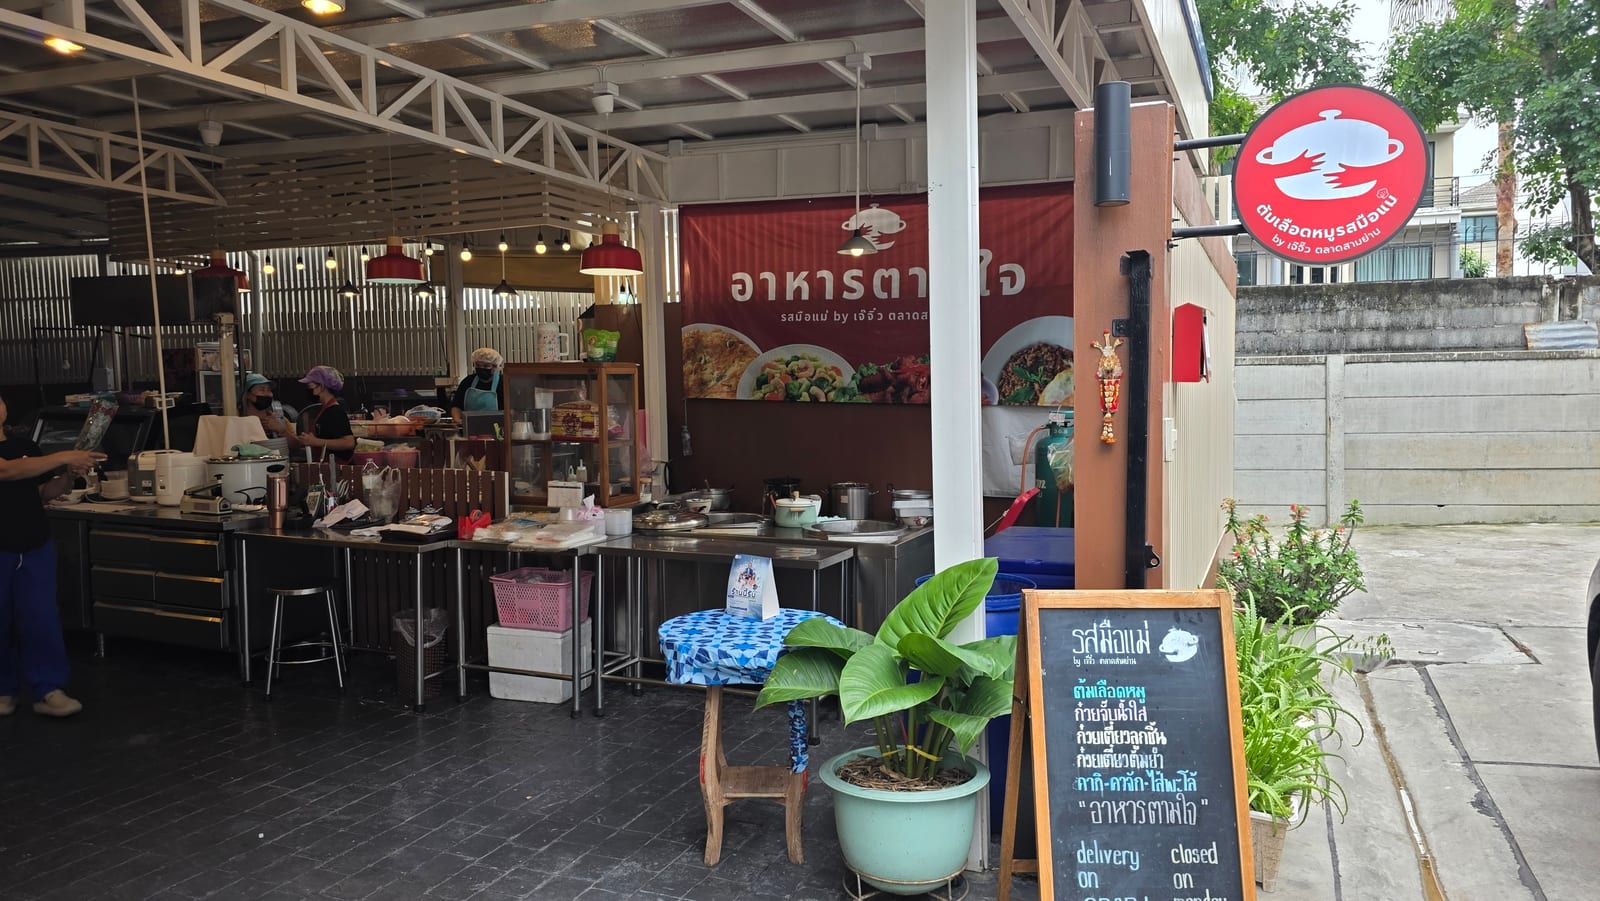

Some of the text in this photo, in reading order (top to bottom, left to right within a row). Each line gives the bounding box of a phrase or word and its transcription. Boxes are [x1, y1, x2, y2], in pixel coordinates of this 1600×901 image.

[1271, 234, 1285, 247] by
[1315, 228, 1381, 254] ตลาดสามย่าน
[781, 310, 829, 322] รสมือแม่
[833, 311, 849, 324] by
[1072, 619, 1151, 654] รสมือแม่
[1072, 656, 1081, 668] by
[1073, 678, 1146, 704] ต้มเลือดหมู
[1076, 840, 1140, 871] delivery
[1171, 841, 1219, 865] closed
[1077, 871, 1099, 888] on
[1173, 872, 1194, 889] on
